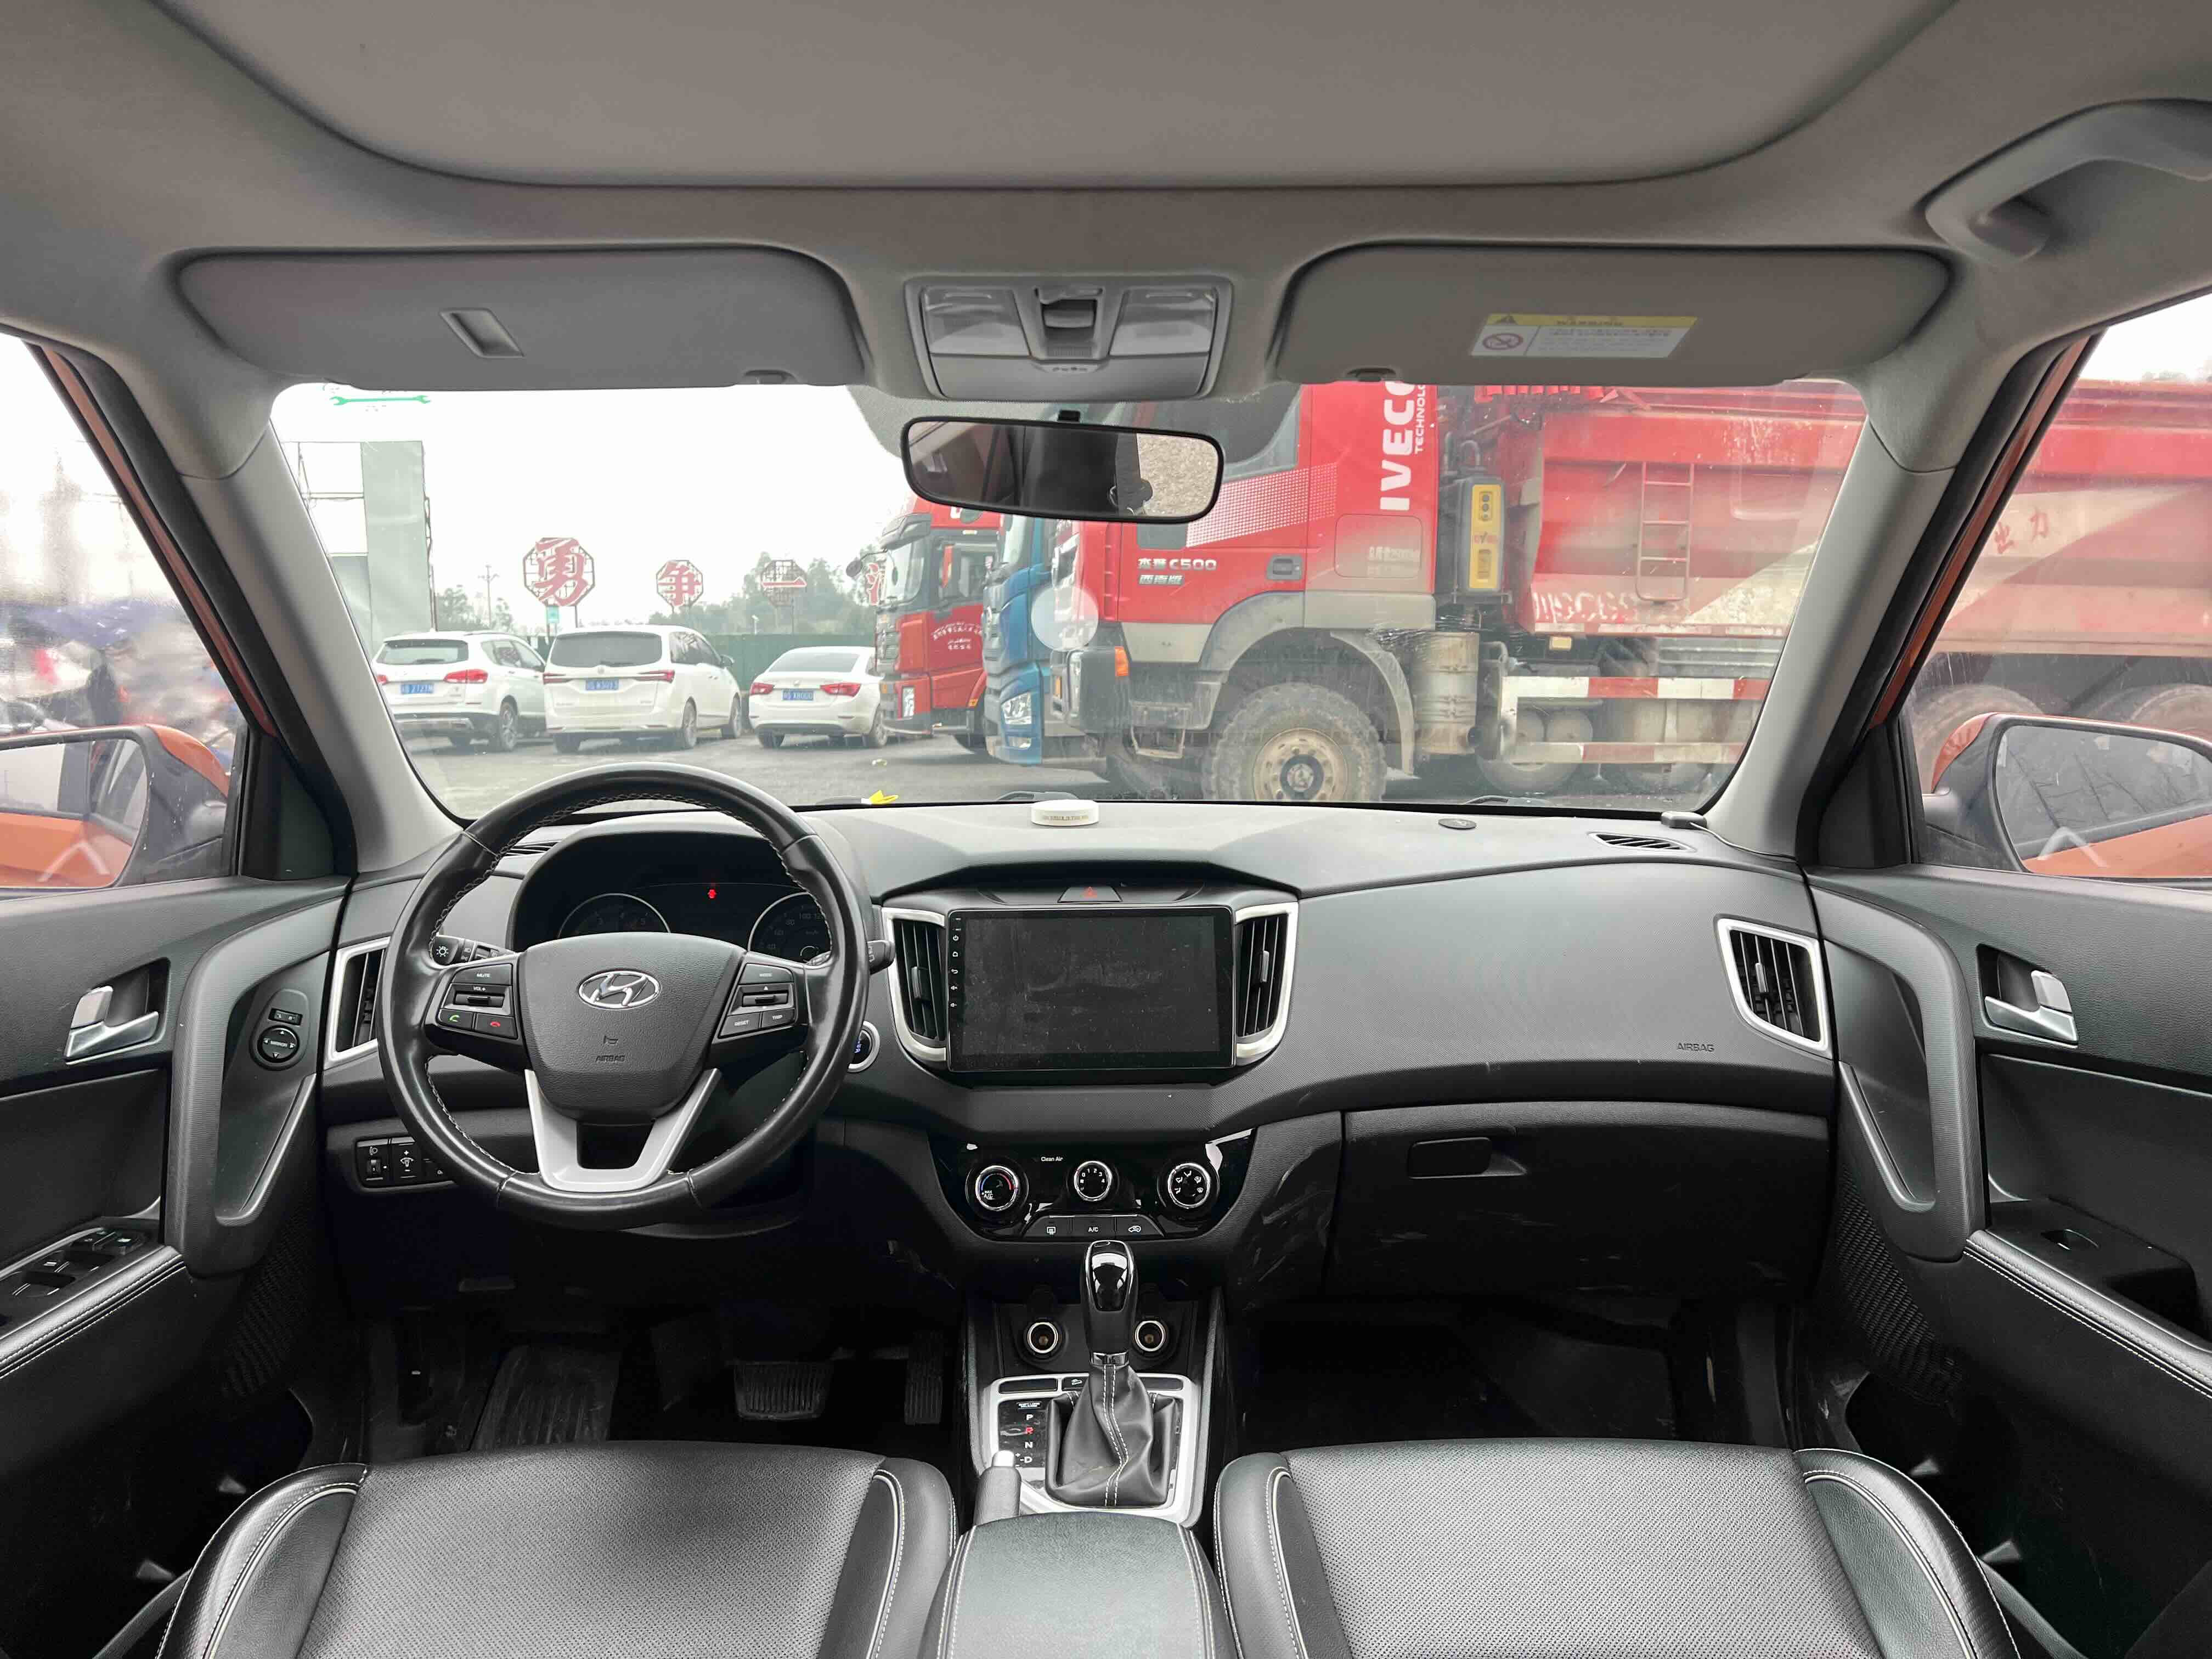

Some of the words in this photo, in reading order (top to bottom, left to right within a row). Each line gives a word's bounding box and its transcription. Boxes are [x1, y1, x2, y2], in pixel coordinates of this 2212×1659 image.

[535, 538, 588, 606] 勇
[658, 561, 702, 606] 争
[1677, 1042, 1714, 1052] AIRBAG
